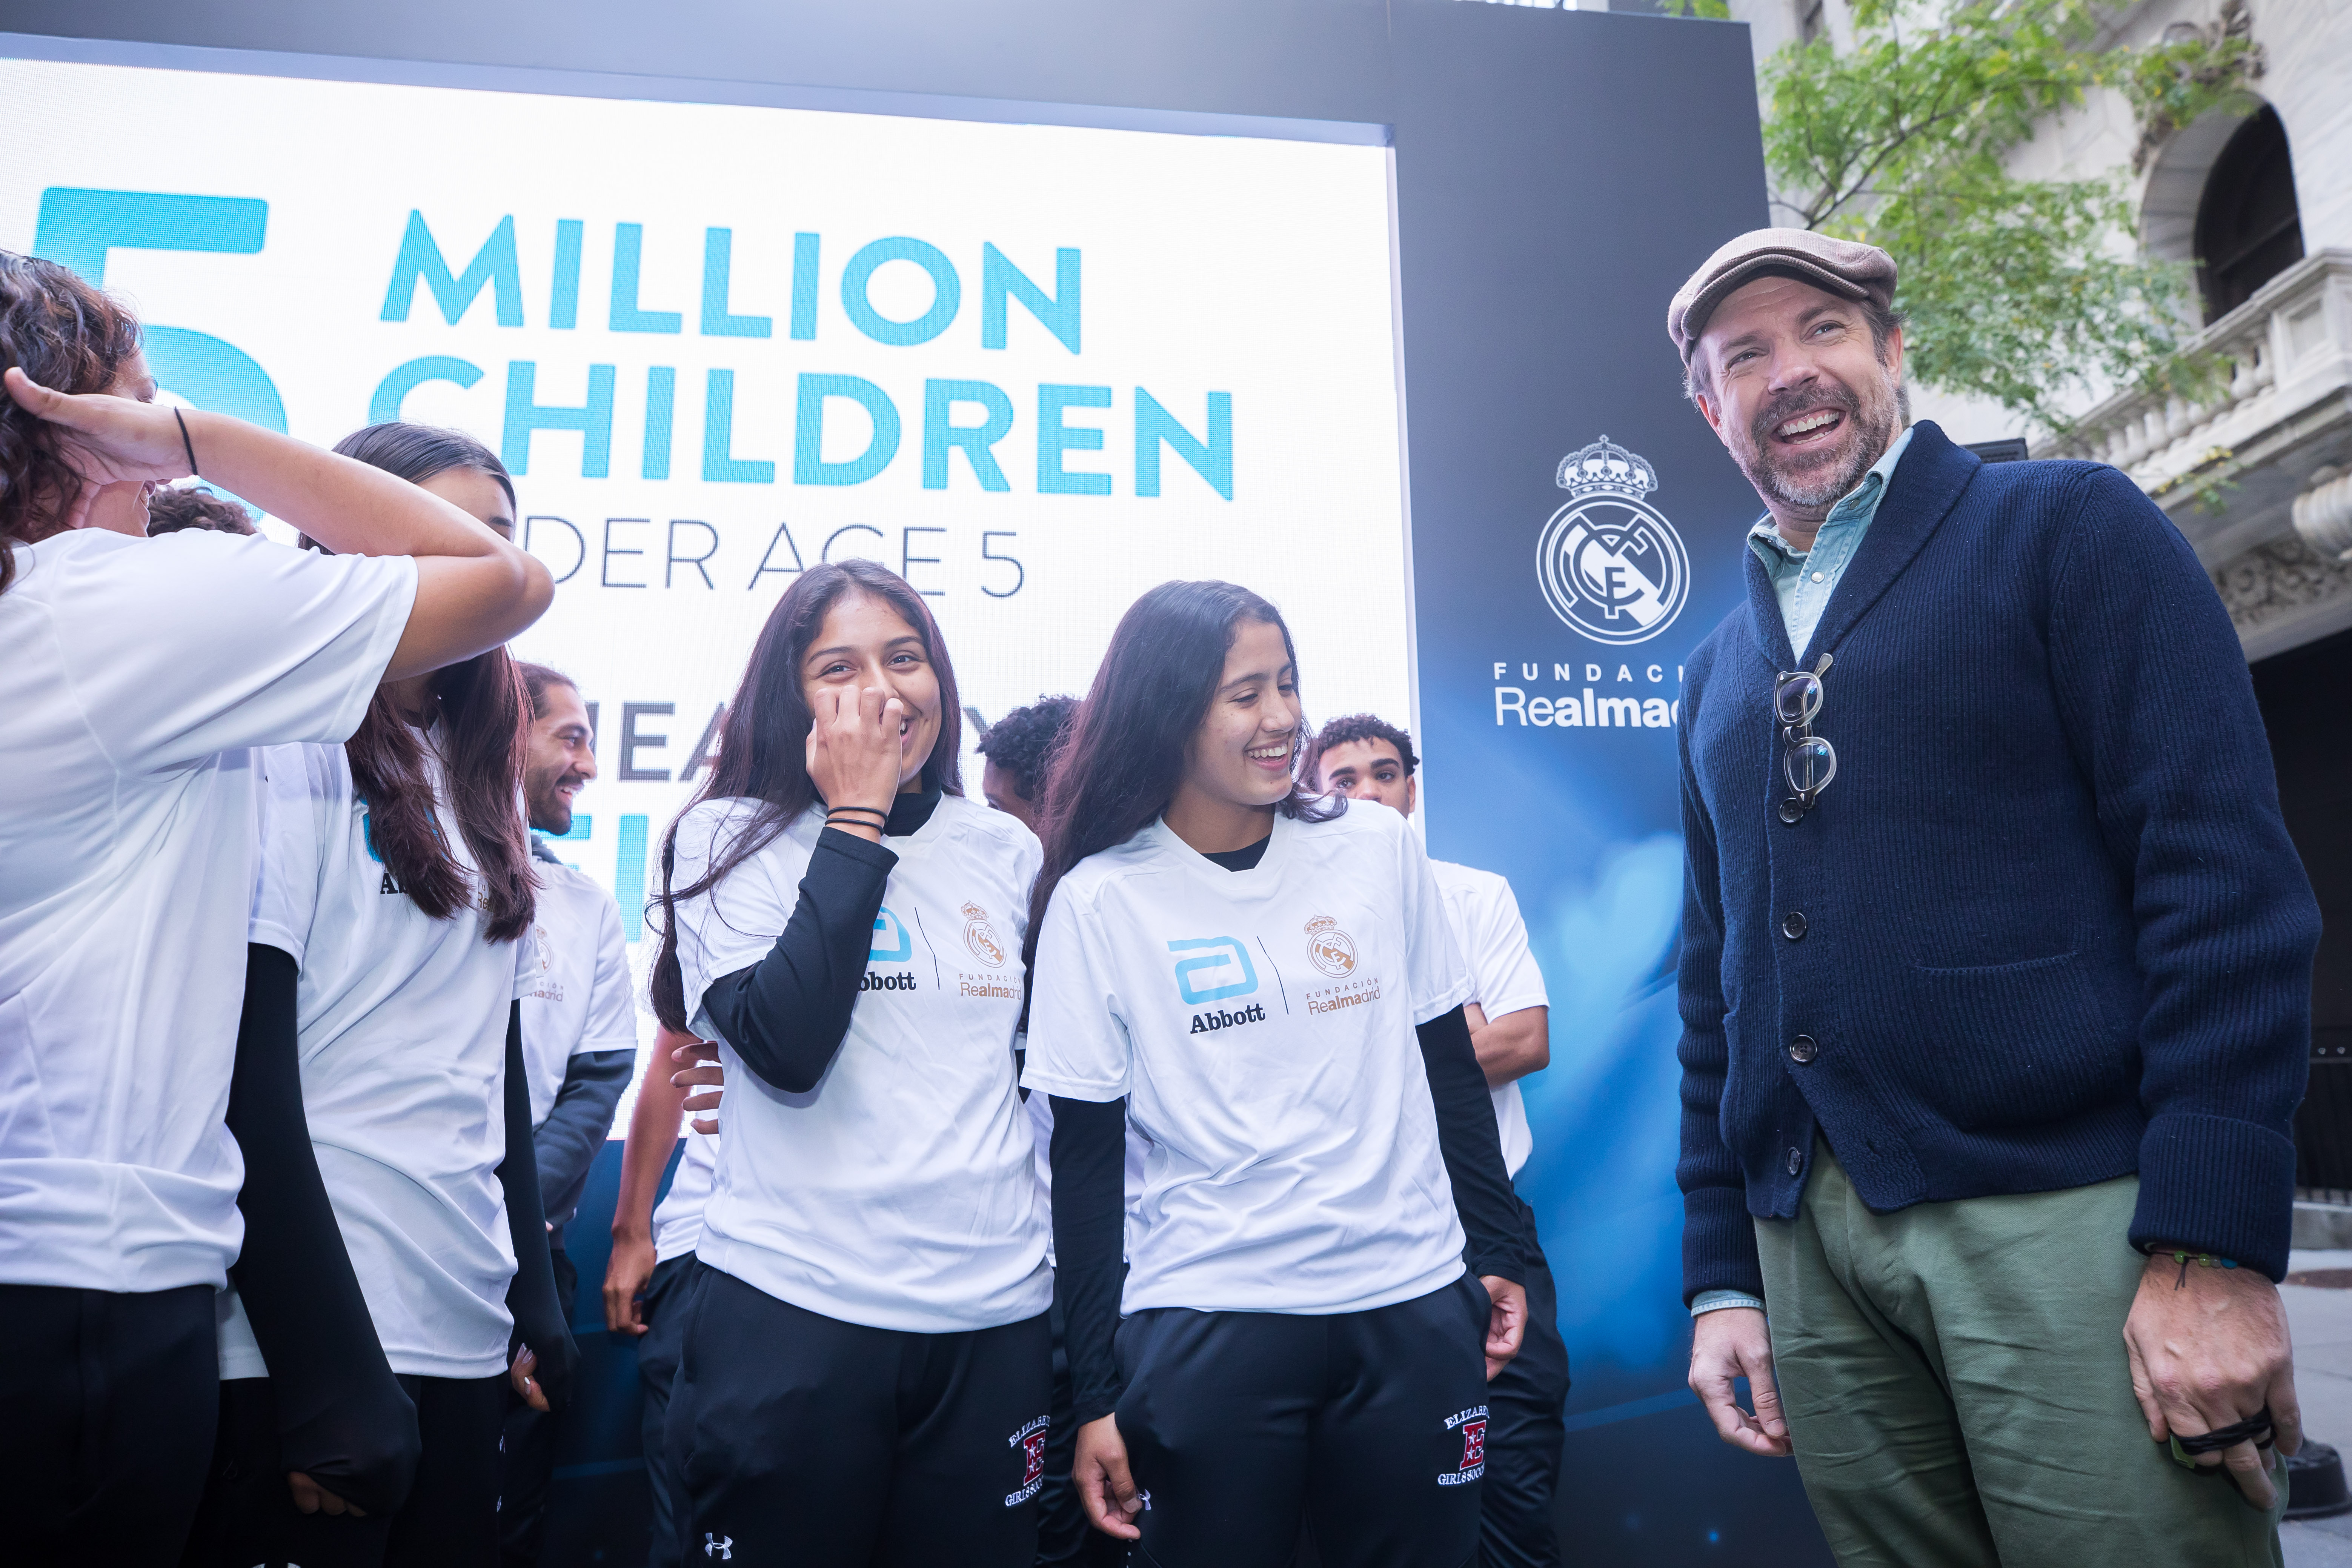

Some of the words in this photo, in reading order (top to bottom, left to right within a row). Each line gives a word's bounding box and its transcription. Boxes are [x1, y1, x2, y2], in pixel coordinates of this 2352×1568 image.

[380, 208, 1082, 355] MILLION
[367, 354, 1234, 501] CHILDREN
[524, 515, 719, 590] DER
[981, 530, 1025, 598] 5
[1493, 662, 1683, 683] FUNDACI
[1495, 686, 1679, 728] Realma
[960, 982, 1021, 1000] Realmadrid
[1306, 977, 1378, 1000] FUNDACIÓN
[1308, 985, 1381, 1016] Realmadrid
[1190, 1003, 1266, 1034] Abbott
[1023, 1429, 1046, 1487] E
[1459, 1419, 1487, 1471] E
